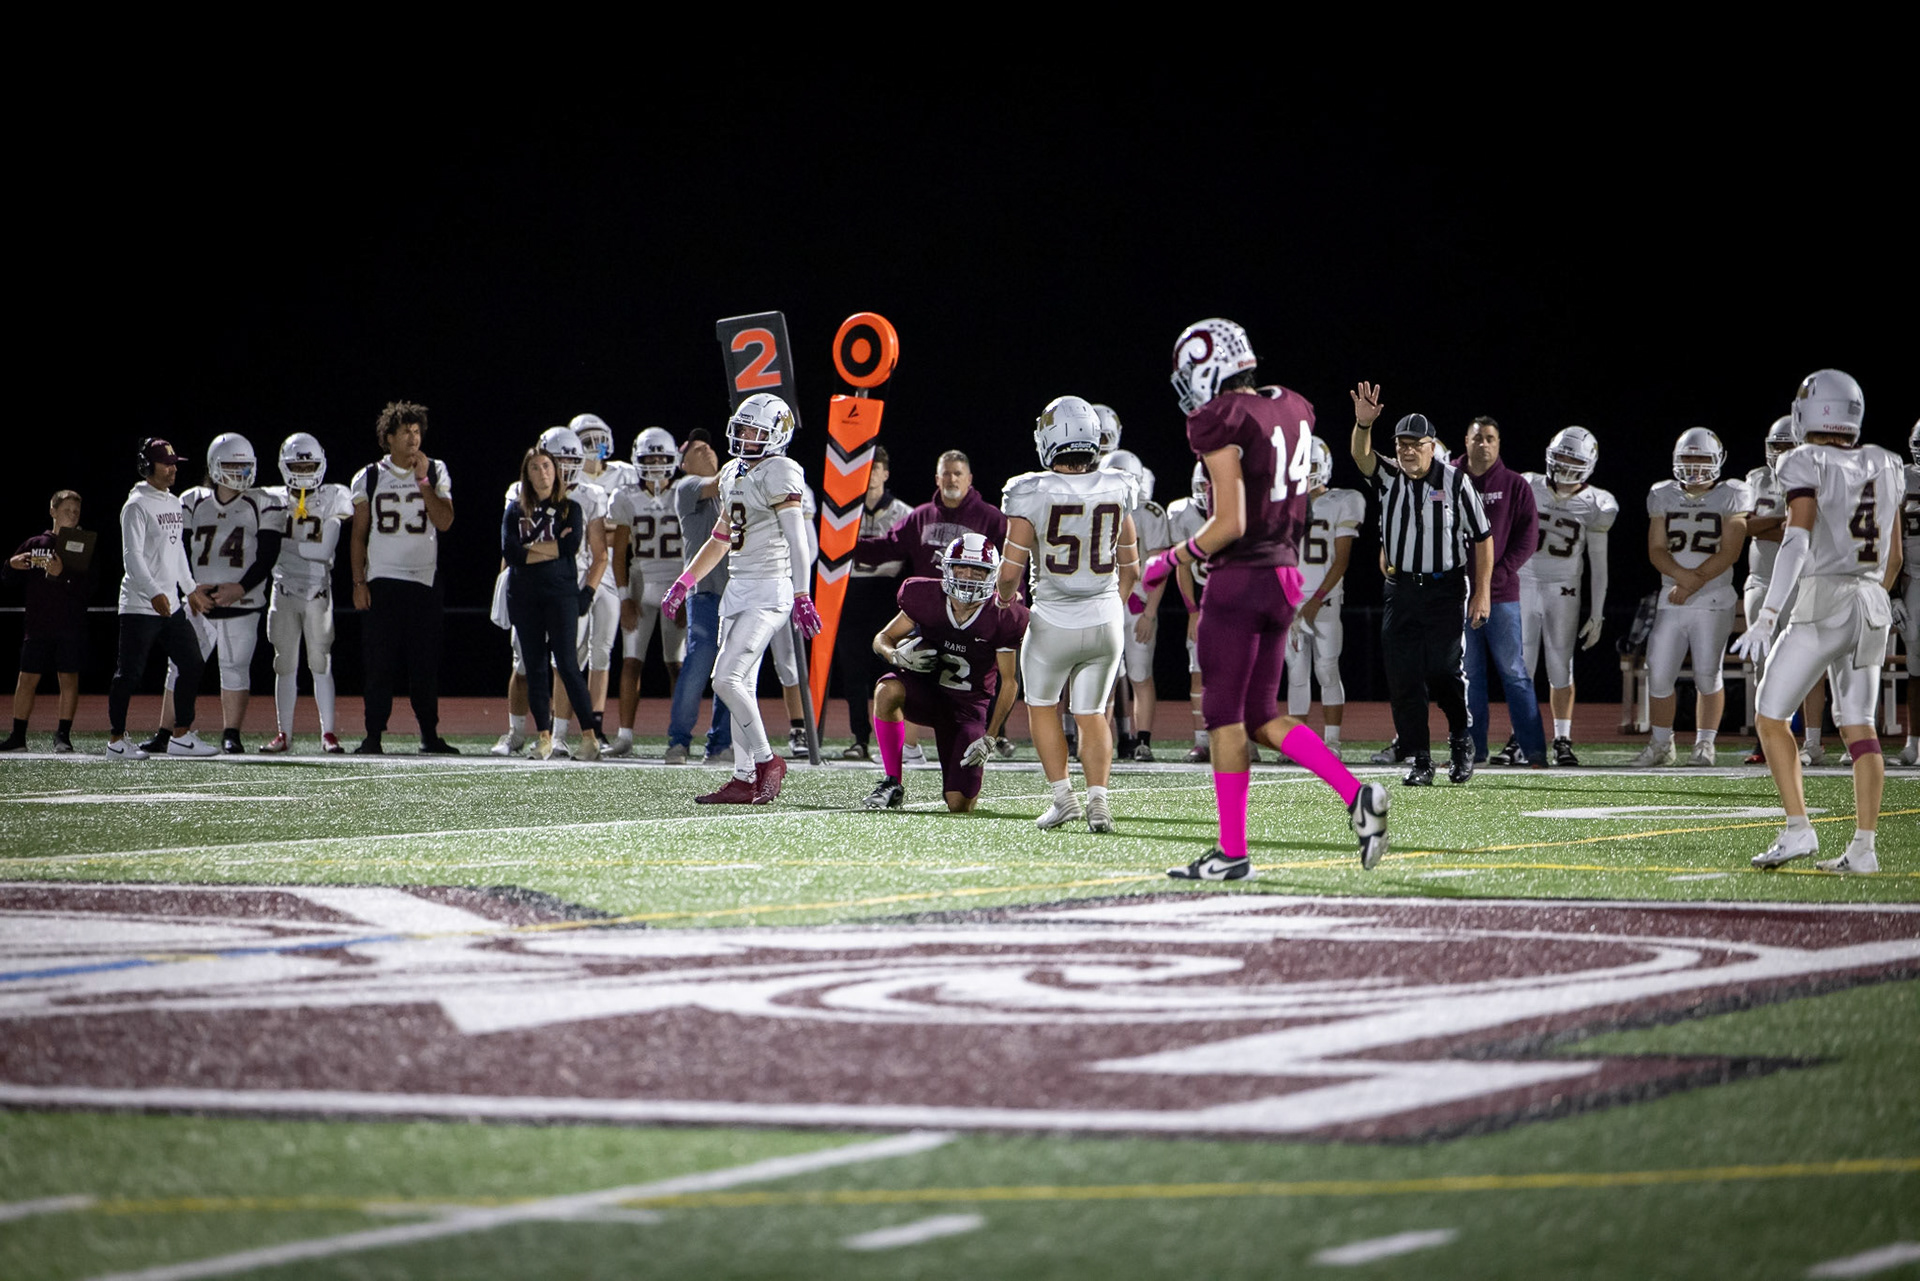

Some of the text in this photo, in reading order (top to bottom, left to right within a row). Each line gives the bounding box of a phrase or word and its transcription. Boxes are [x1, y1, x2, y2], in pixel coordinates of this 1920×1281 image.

[731, 328, 782, 392] 2
[1270, 420, 1313, 502] 14
[376, 492, 427, 534] 63
[1665, 511, 1722, 554] 52
[1848, 480, 1881, 563] 4
[194, 525, 245, 569] 74
[633, 516, 682, 559] 22
[1045, 503, 1122, 575] 50
[1561, 587, 1577, 597] M
[944, 640, 967, 653] RAMS
[939, 653, 972, 692] 2
